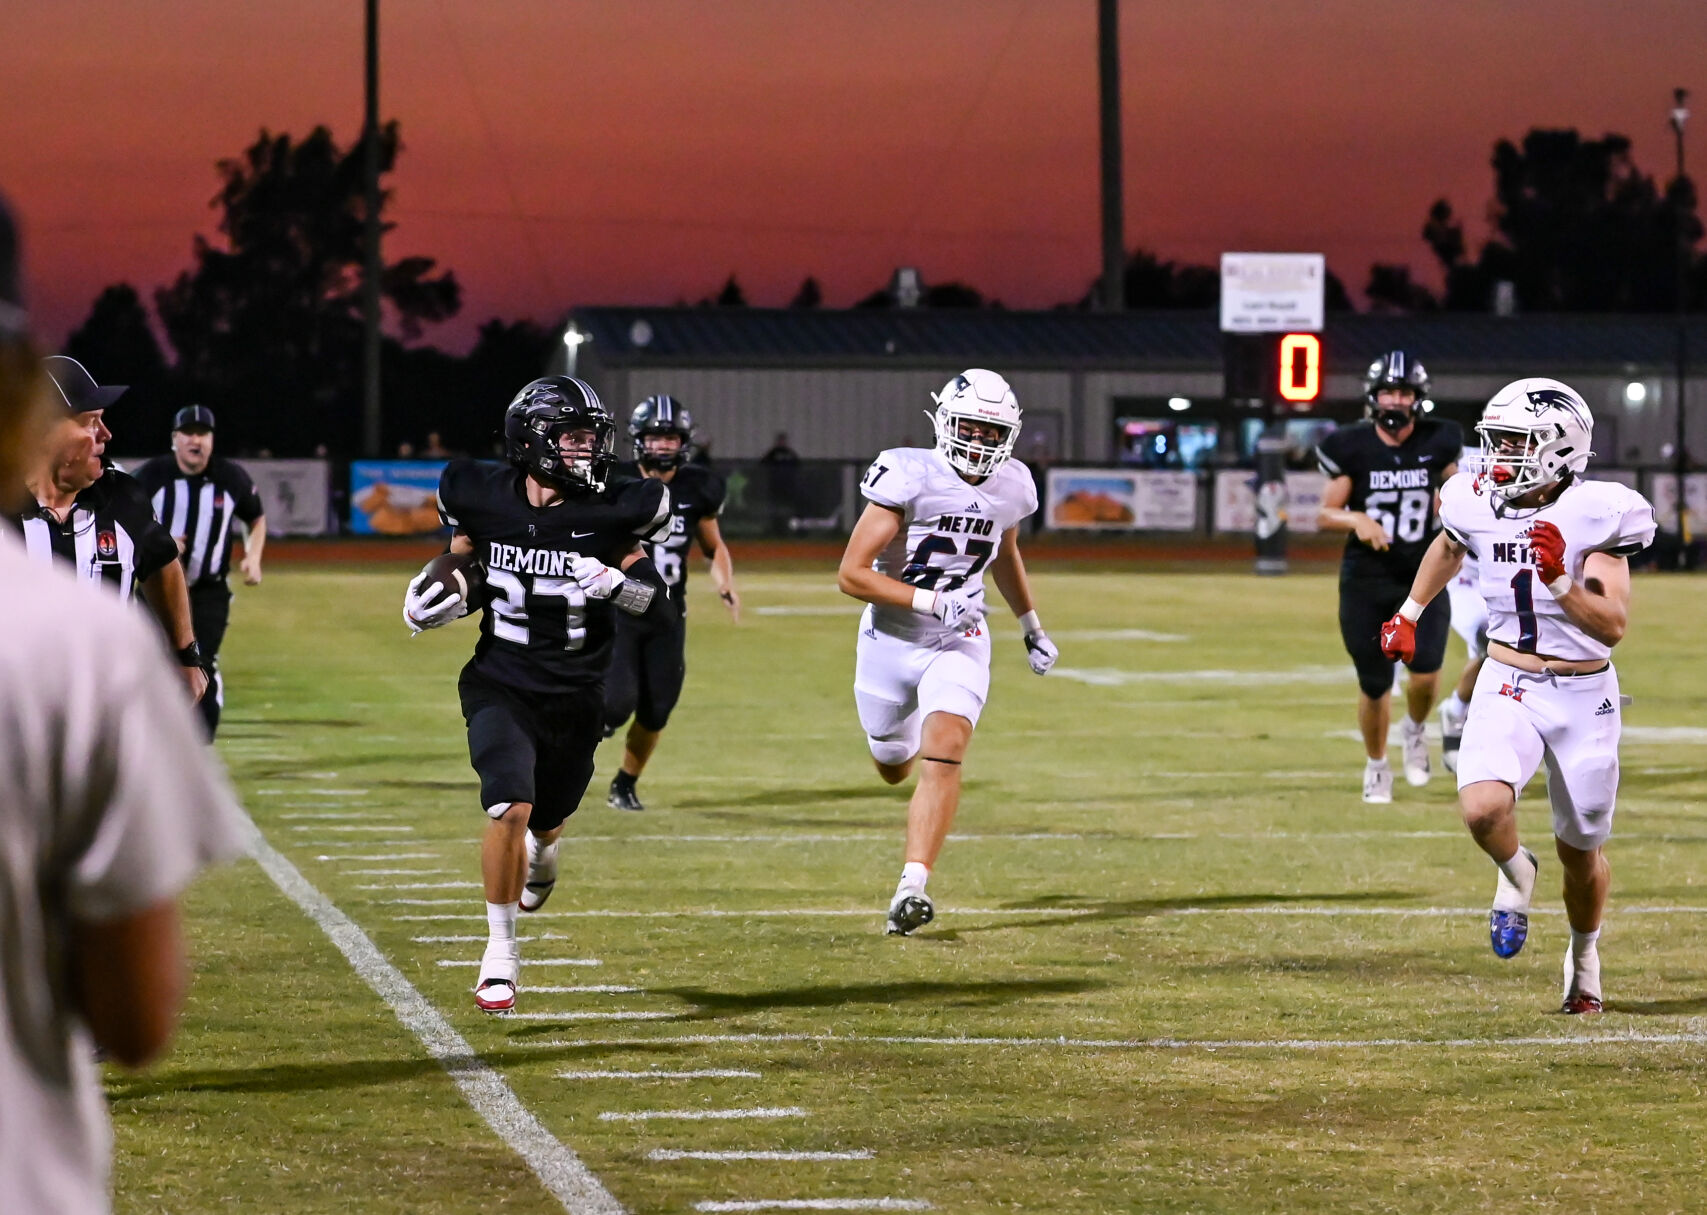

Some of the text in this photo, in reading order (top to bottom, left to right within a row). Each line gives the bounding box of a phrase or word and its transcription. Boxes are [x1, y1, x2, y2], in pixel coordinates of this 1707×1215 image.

[1279, 333, 1320, 401] 0
[1369, 468, 1429, 489] DEMONS
[937, 515, 994, 536] METRO
[1493, 543, 1536, 564] MET
[902, 534, 994, 592] 67
[486, 566, 587, 651] 27
[1510, 568, 1537, 653] 1
